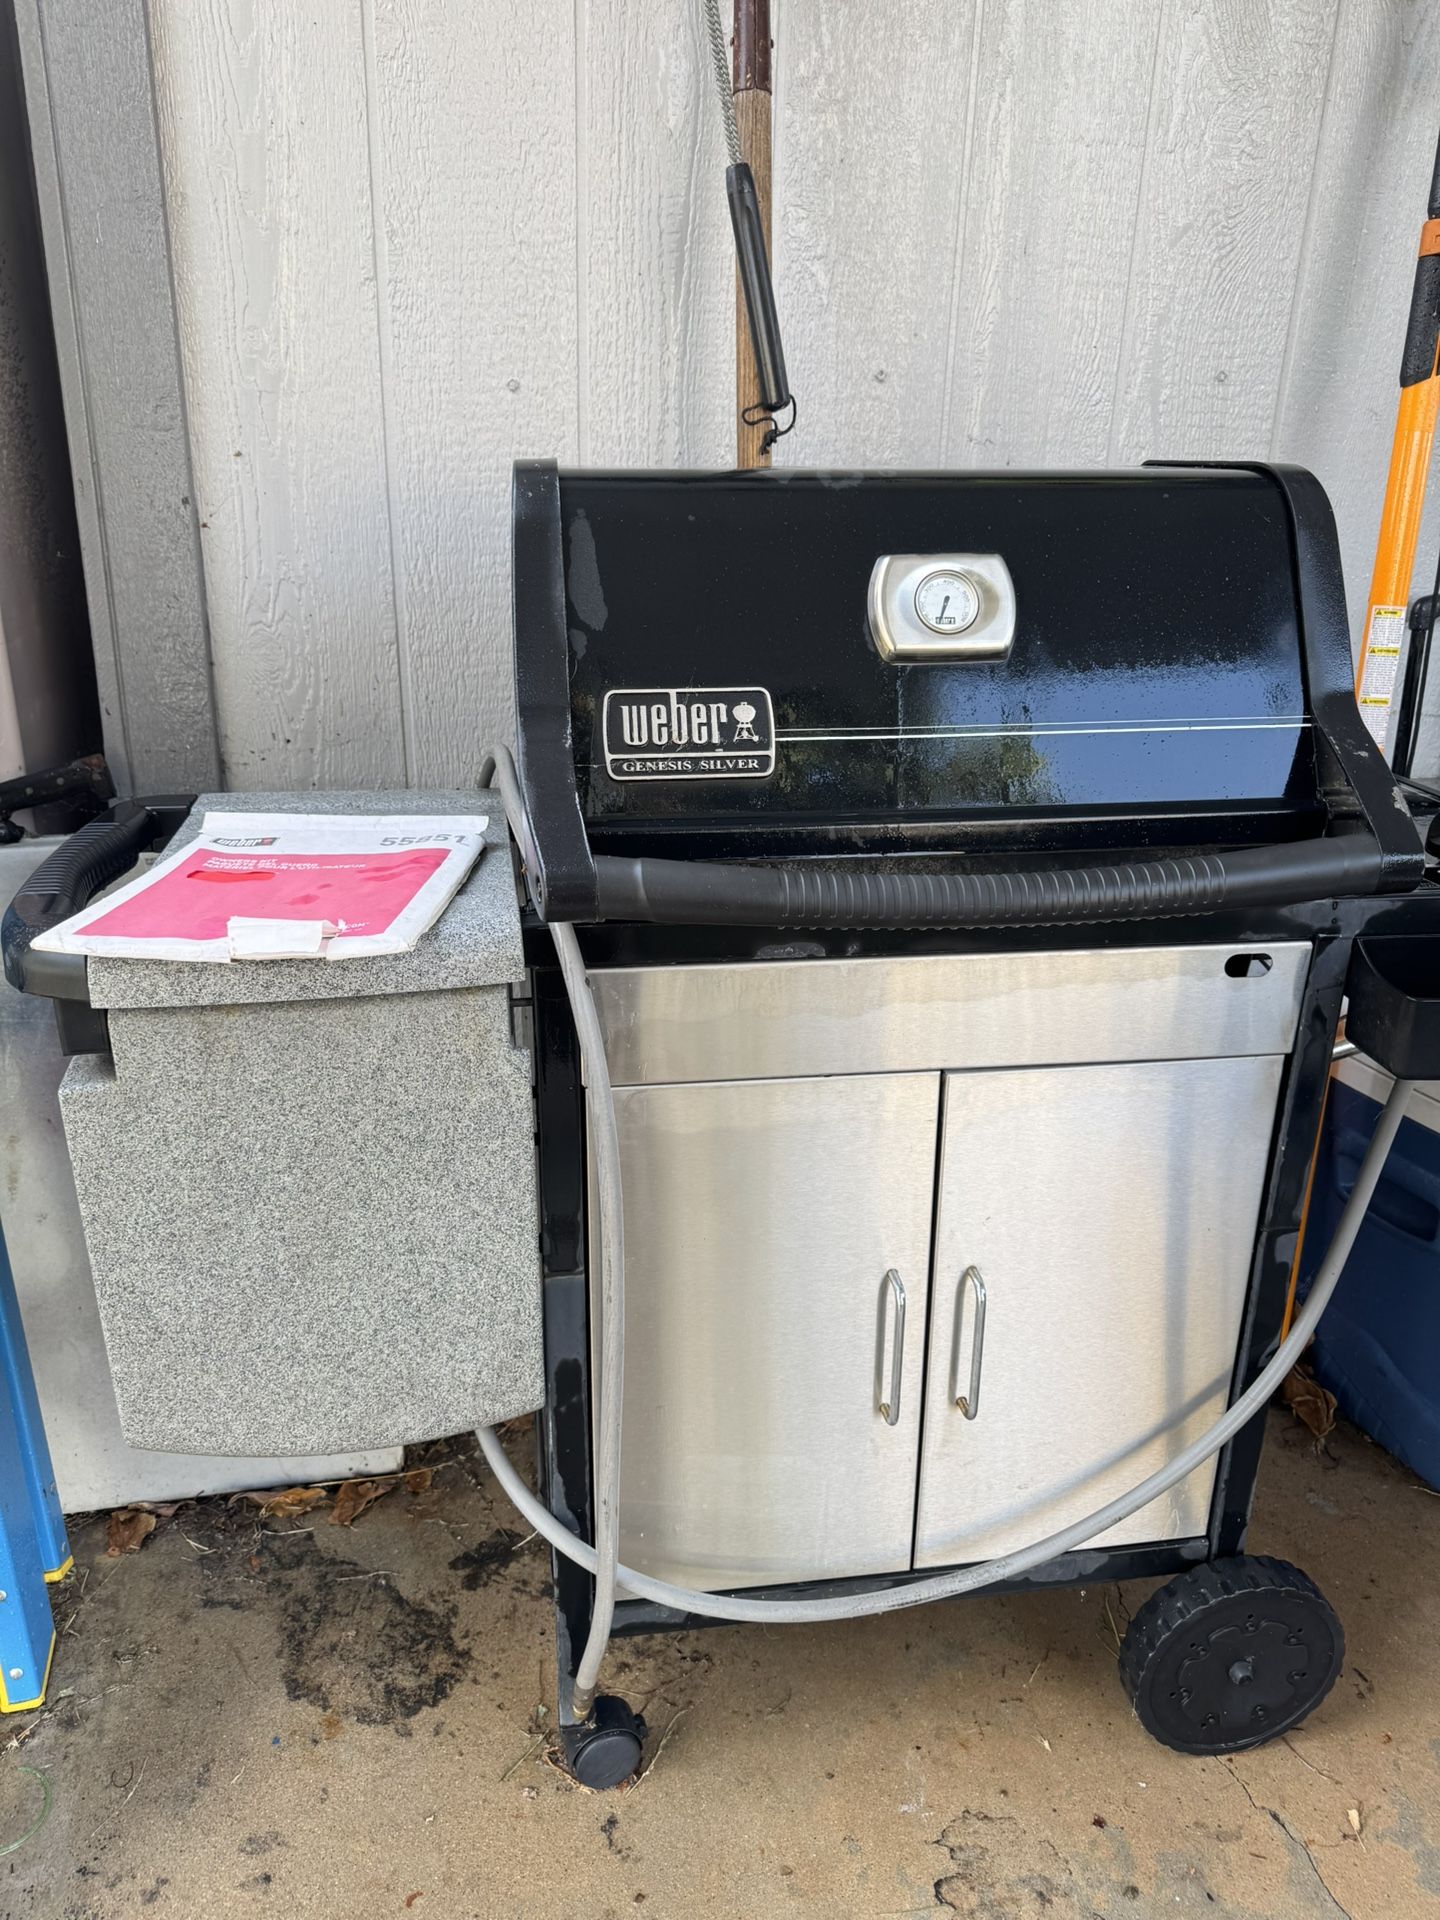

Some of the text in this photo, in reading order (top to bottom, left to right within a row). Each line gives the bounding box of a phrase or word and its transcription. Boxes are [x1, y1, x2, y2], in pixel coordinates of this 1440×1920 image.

[620, 689, 728, 746] weber
[622, 758, 760, 772] GENESIS SILVER
